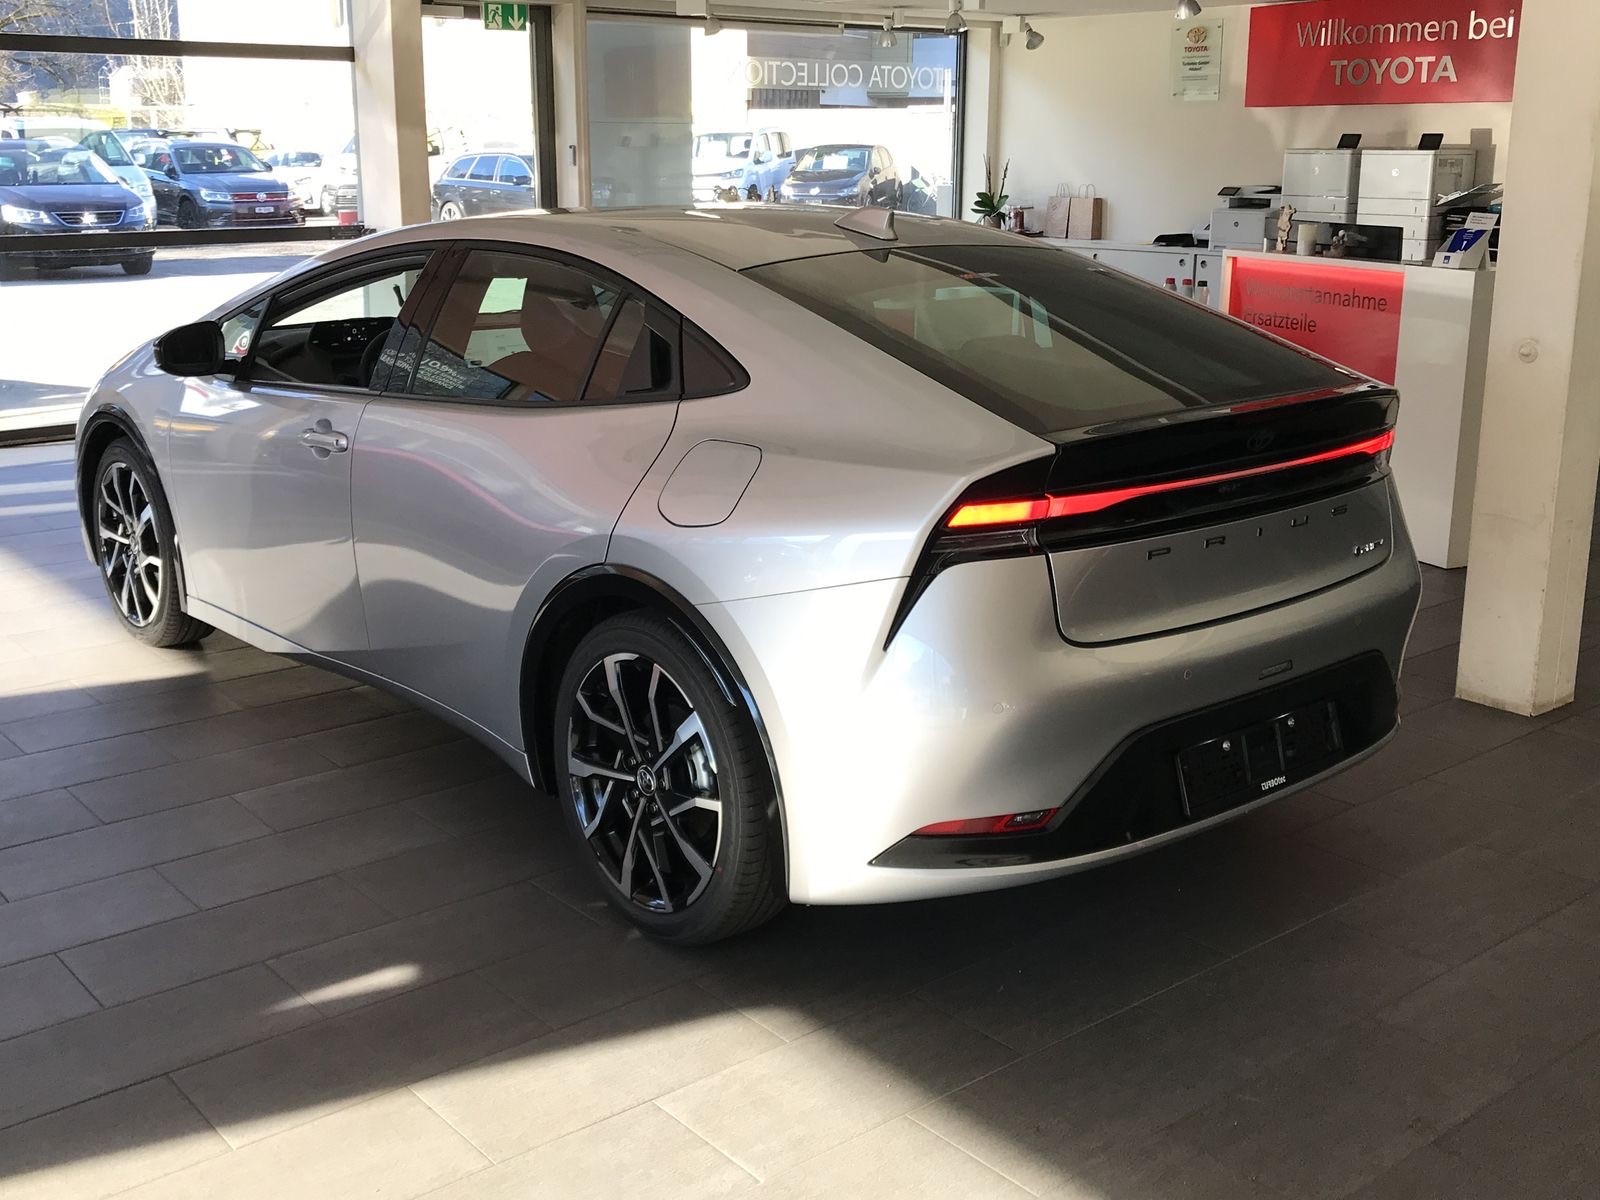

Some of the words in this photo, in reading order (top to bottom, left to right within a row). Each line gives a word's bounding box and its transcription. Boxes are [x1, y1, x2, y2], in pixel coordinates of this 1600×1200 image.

[1297, 18, 1458, 47] Willkommen
[1468, 9, 1515, 40] bei
[1184, 45, 1209, 53] TOYOTA
[1330, 55, 1458, 86] TOYOTA
[1244, 305, 1317, 333] Ersatzteile
[1146, 504, 1348, 561] PRIUS
